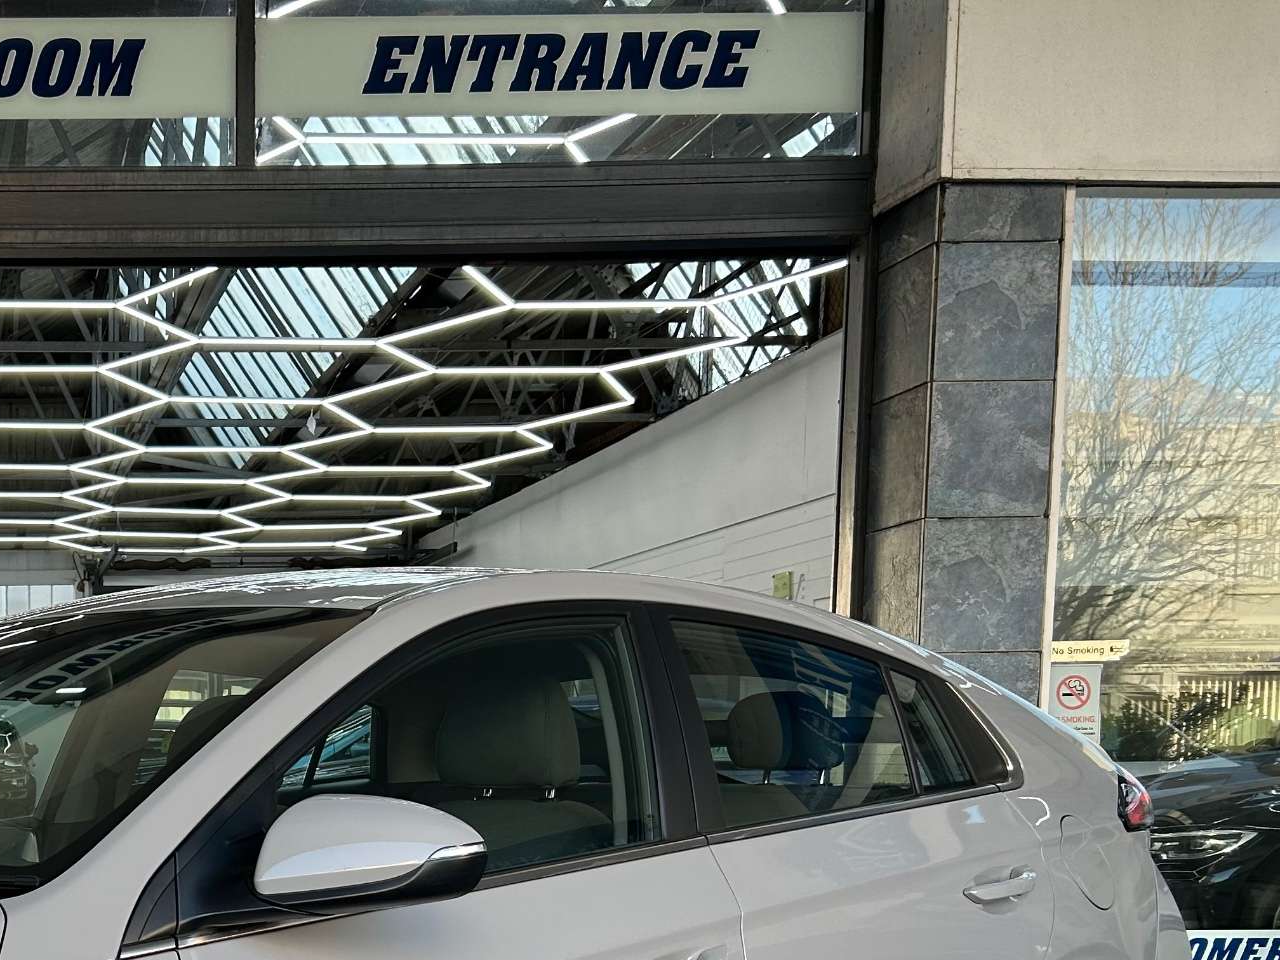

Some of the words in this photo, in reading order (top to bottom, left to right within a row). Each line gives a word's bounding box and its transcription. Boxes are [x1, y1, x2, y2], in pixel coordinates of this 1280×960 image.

[362, 29, 761, 95] ENTRANCE
[1052, 647, 1064, 655] No
[1067, 646, 1105, 655] Smoking
